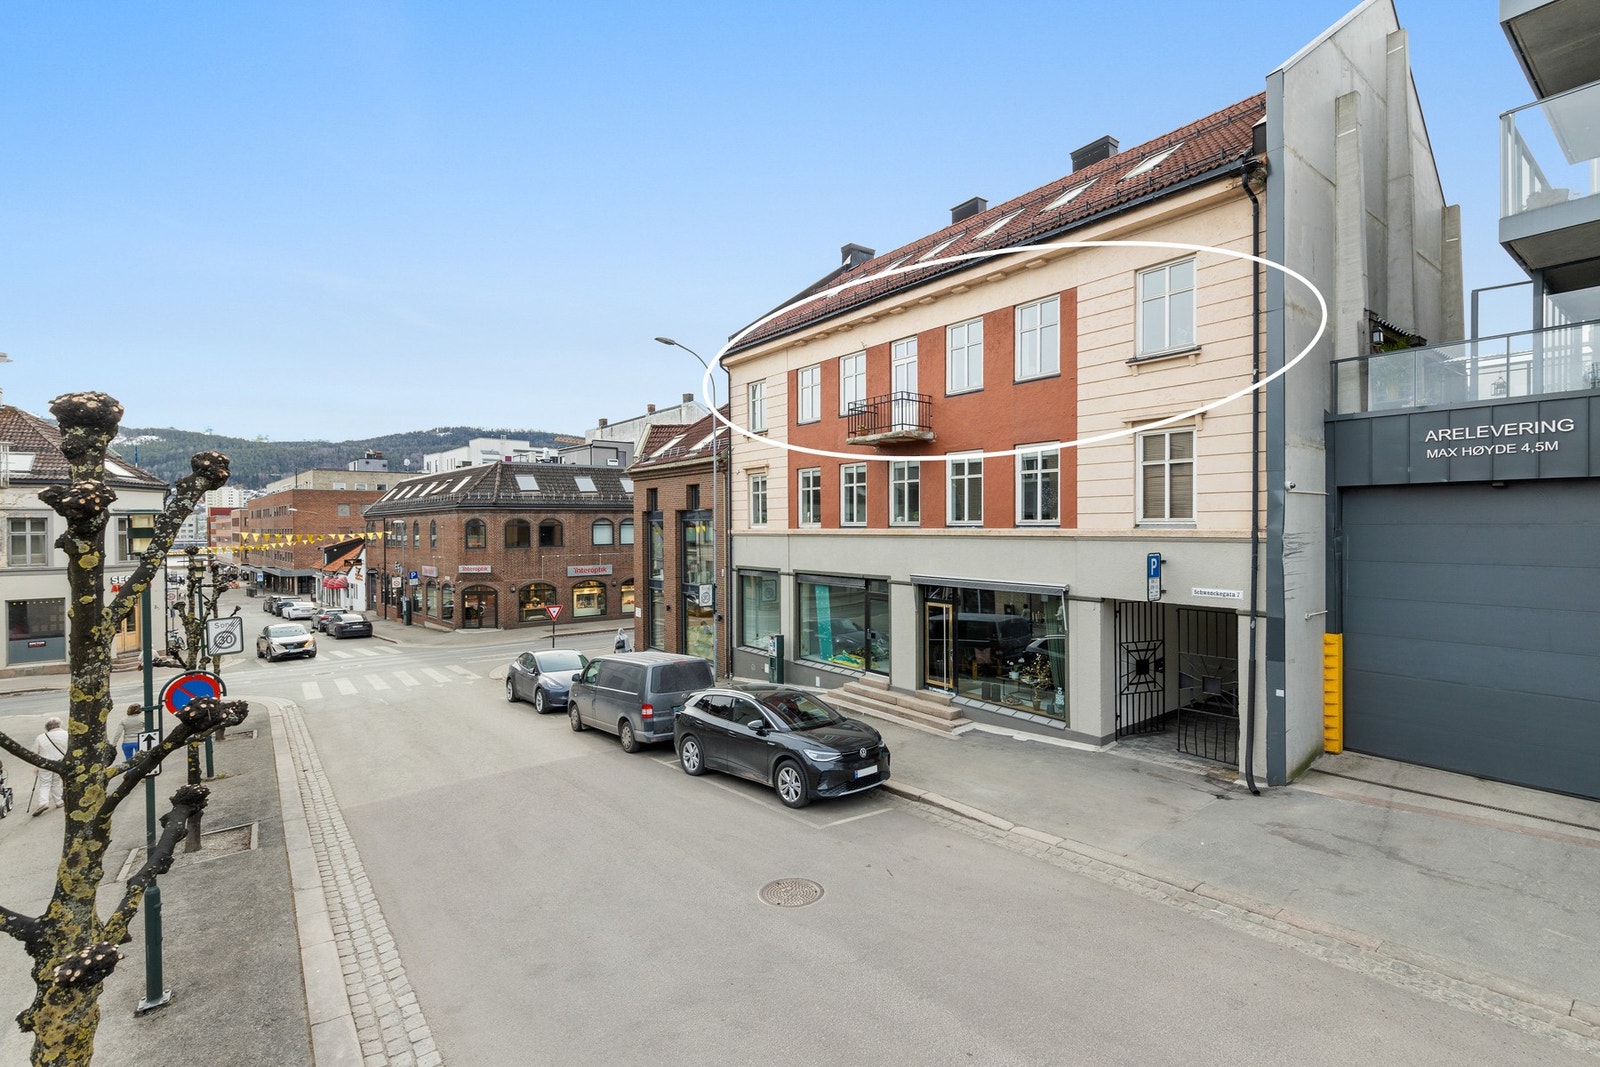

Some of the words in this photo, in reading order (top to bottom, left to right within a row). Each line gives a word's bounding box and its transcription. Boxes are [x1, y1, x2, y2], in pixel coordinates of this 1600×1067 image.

[1424, 418, 1575, 442] ARELEVERING
[1426, 447, 1458, 459] MAX
[1461, 443, 1517, 456] HØYDE
[1520, 440, 1559, 454] 4,5M
[1151, 558, 1158, 576] P
